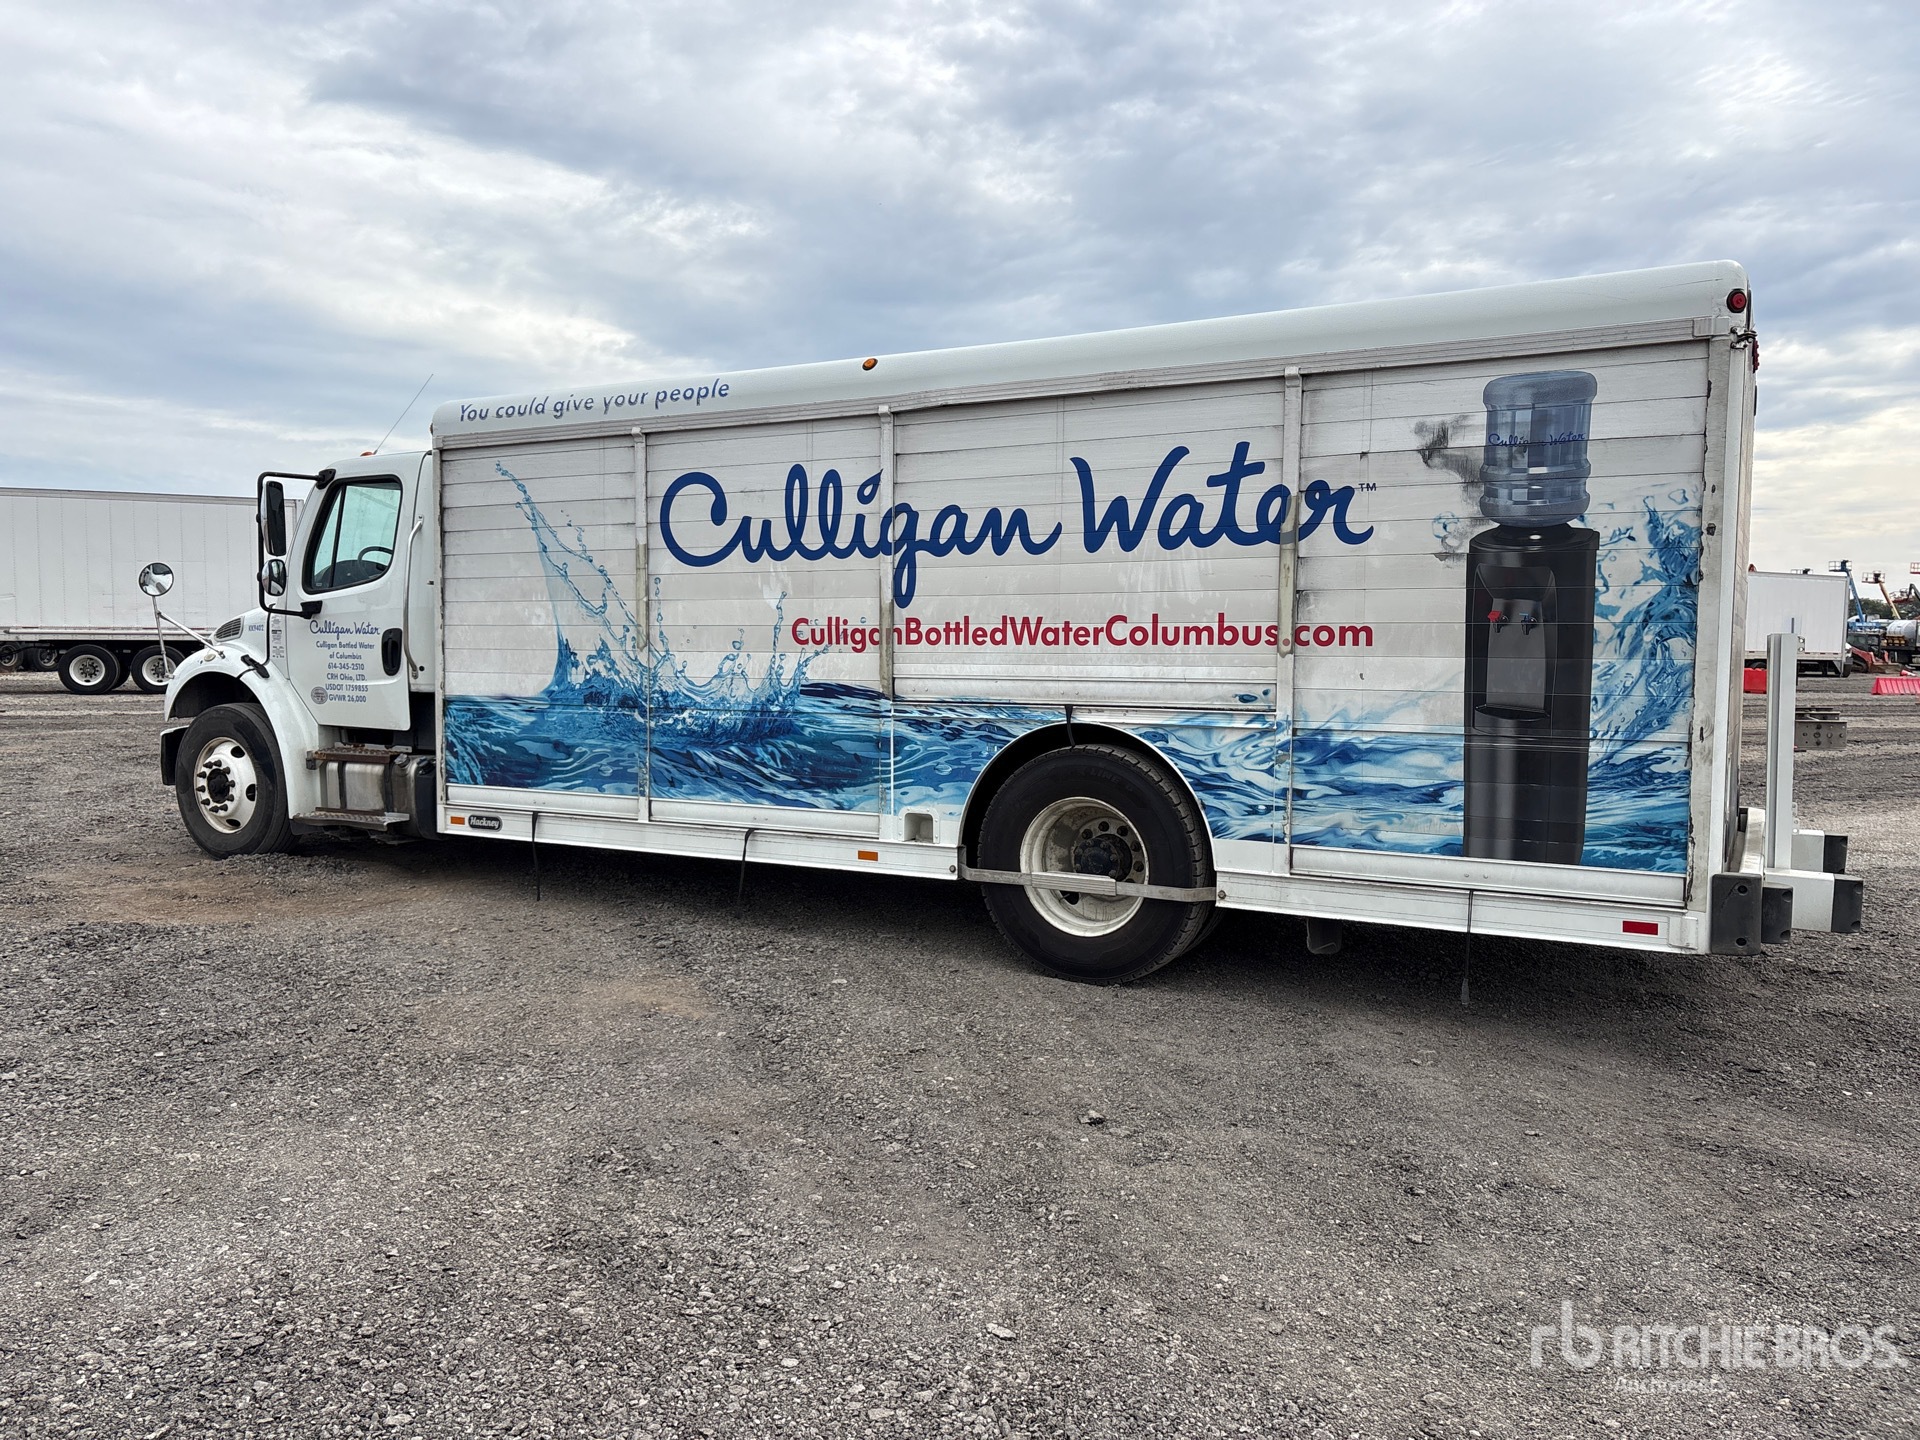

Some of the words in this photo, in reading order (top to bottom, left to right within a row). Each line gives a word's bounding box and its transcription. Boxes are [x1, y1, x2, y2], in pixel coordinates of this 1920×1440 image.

[460, 403, 489, 422] You
[495, 396, 549, 418] could
[554, 394, 595, 420] give
[603, 390, 649, 415] your
[655, 378, 730, 409] people
[659, 463, 1063, 609] Culligan
[1069, 441, 1374, 553] Water
[310, 619, 353, 640] Culligan
[353, 621, 380, 635] Water
[791, 612, 1374, 653] CulliganBottledWaterColumbus.com
[316, 640, 338, 650] Culligan
[338, 641, 358, 650] Bottled
[358, 642, 375, 650] Water
[336, 651, 362, 660] Columbus
[327, 662, 365, 670] 614-345-2510
[326, 672, 338, 680] CRH
[339, 673, 355, 681] Ohio,
[325, 683, 344, 691] USDOT
[345, 684, 369, 692] 1759855
[328, 693, 346, 702] GVWR
[347, 694, 367, 703] 26,000
[470, 816, 499, 829] Hackney
